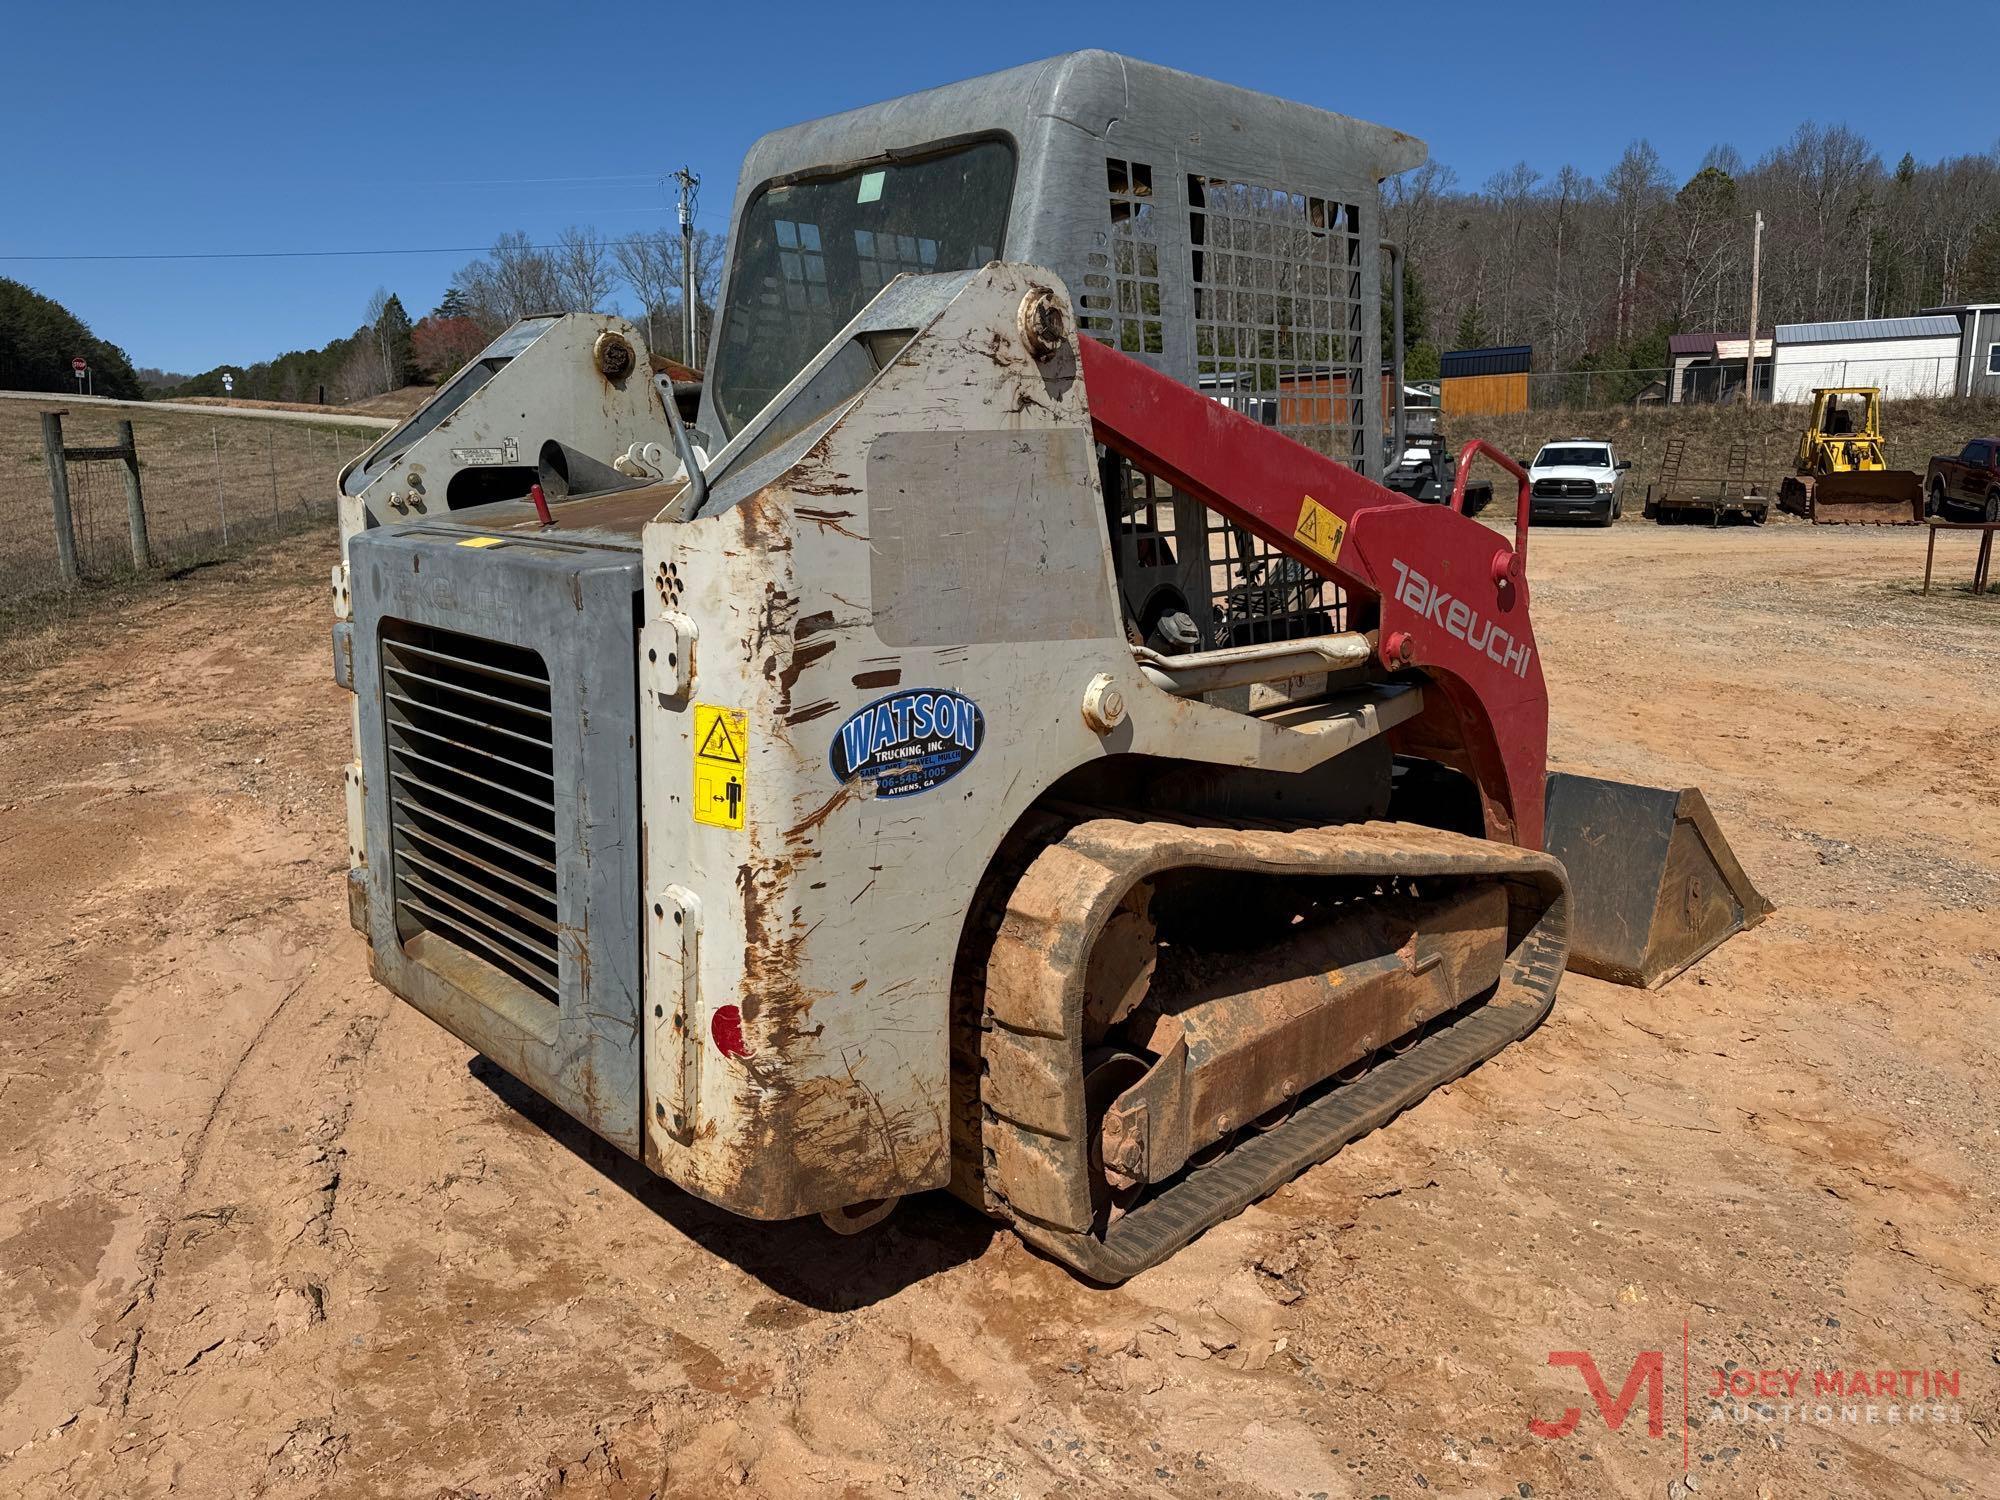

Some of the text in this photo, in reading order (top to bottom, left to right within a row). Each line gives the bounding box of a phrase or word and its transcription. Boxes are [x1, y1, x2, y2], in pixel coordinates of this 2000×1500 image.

[842, 694, 975, 773] WATSON
[875, 740, 946, 762] TRUCKING, INC.
[938, 751, 961, 762] MULCH
[888, 783, 922, 795] ATHENS,
